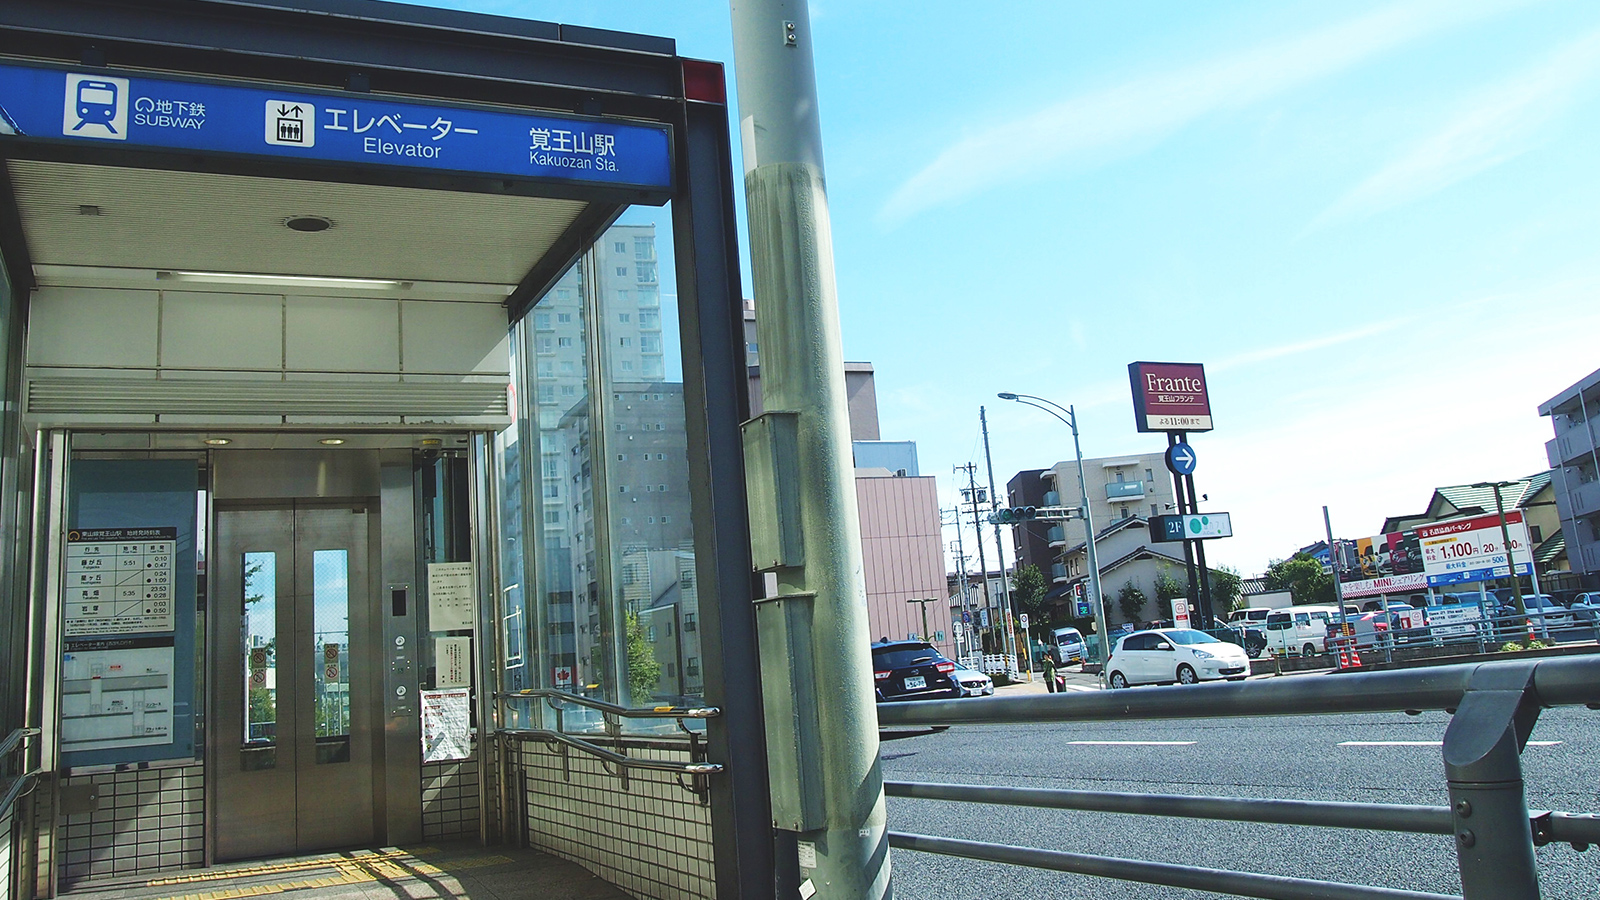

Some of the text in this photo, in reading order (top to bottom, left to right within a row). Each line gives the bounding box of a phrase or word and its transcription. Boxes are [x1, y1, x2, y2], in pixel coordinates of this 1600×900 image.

[155, 99, 206, 117] 地下鉄
[134, 113, 205, 129] SUBWAY
[323, 108, 479, 141] エレベーター
[364, 137, 442, 159] Elevator
[529, 127, 616, 157] 覚王山駅
[529, 150, 620, 172] Kakuozan Sta.
[1145, 373, 1202, 392] Frante
[1157, 394, 1195, 403] 覚王山フランテ
[1168, 521, 1182, 533] 2F
[1445, 561, 1467, 570] 最大料金
